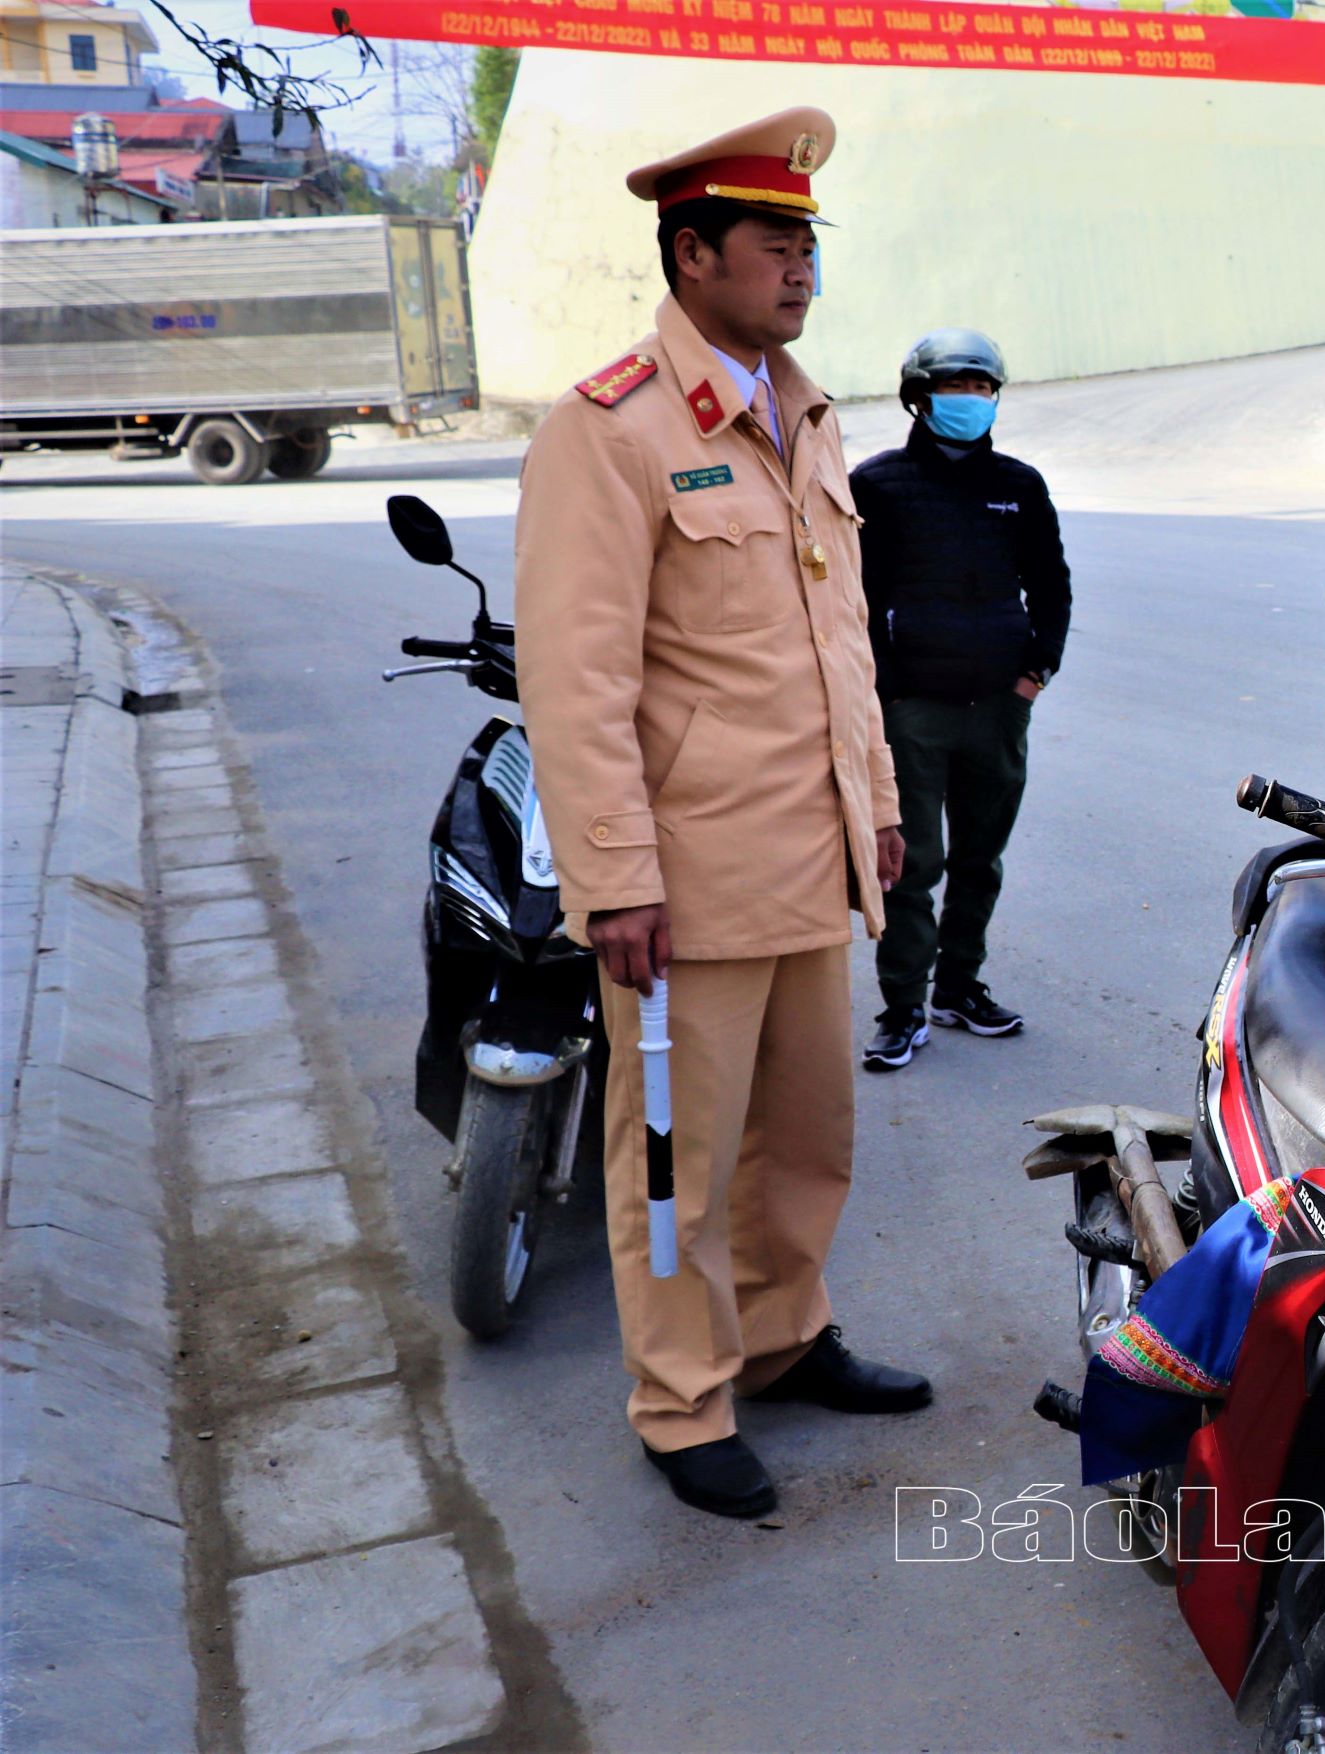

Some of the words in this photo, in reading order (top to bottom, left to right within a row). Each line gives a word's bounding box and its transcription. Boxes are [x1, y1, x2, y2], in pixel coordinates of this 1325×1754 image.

[762, 2, 781, 24] 78
[789, 4, 826, 26] NĂM
[834, 5, 874, 28] NGÀY
[883, 9, 932, 31] THÀNH
[938, 11, 967, 36] LẬP
[974, 13, 1015, 34] QUÂN
[1020, 14, 1046, 38] ĐỘI
[1052, 16, 1094, 37] NHÂN
[1099, 18, 1130, 38] DÂN
[1135, 19, 1165, 42] VIỆT
[1172, 24, 1206, 42] NAM
[659, 27, 681, 49] VÀ
[690, 32, 710, 52] 33
[718, 33, 756, 54] NĂM
[764, 34, 805, 55] NGÀY
[816, 36, 843, 60] HỘI
[850, 37, 890, 61] QUỐC
[898, 40, 949, 61] PHÒNG
[956, 43, 996, 62] TOÀN
[1002, 44, 1034, 63] DÂN
